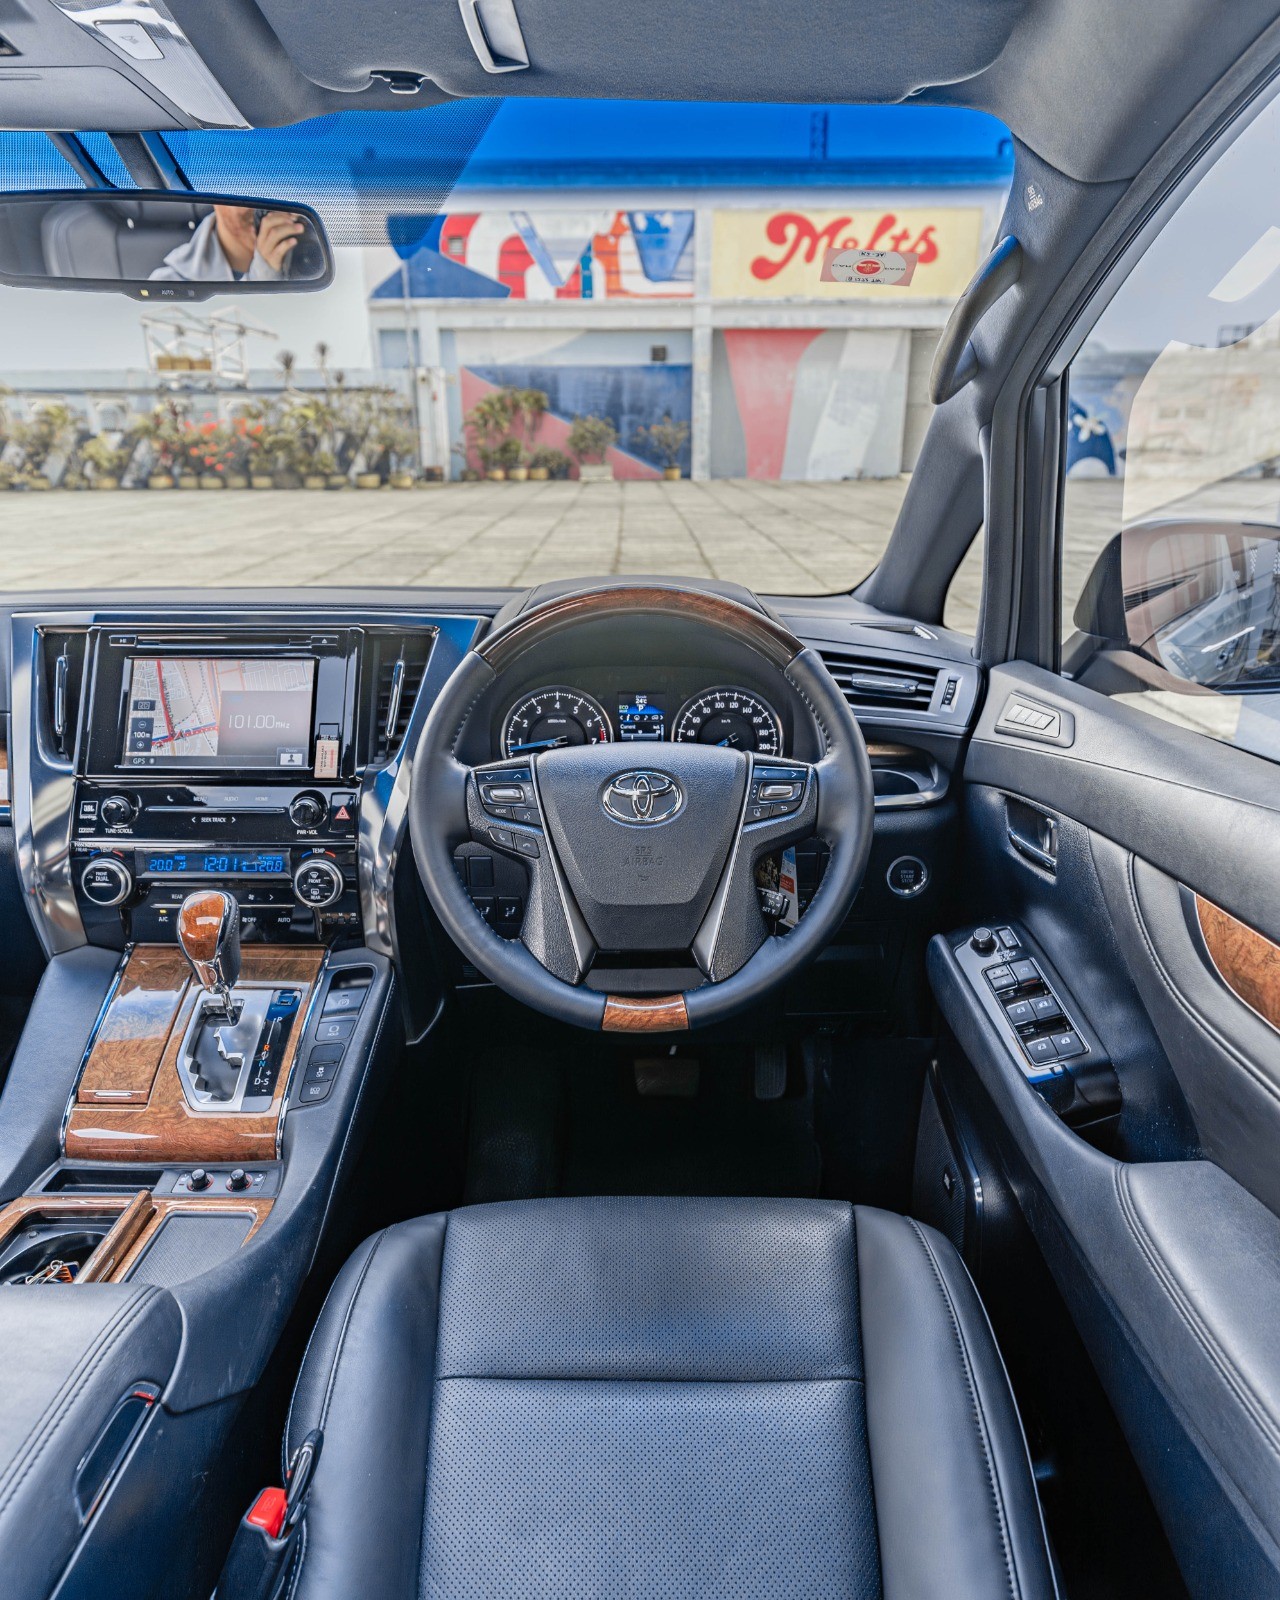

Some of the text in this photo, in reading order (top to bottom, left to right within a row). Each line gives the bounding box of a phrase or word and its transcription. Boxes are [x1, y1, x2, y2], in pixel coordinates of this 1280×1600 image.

[554, 701, 560, 709] 4
[638, 704, 644, 712] P
[536, 706, 542, 714] 3
[573, 706, 579, 714] 5
[523, 719, 529, 728] 2
[586, 719, 592, 727] 6
[591, 737, 597, 745] 7
[149, 860, 173, 871] 20.0
[204, 857, 237, 871] 12:01
[259, 860, 283, 872] 20.0
